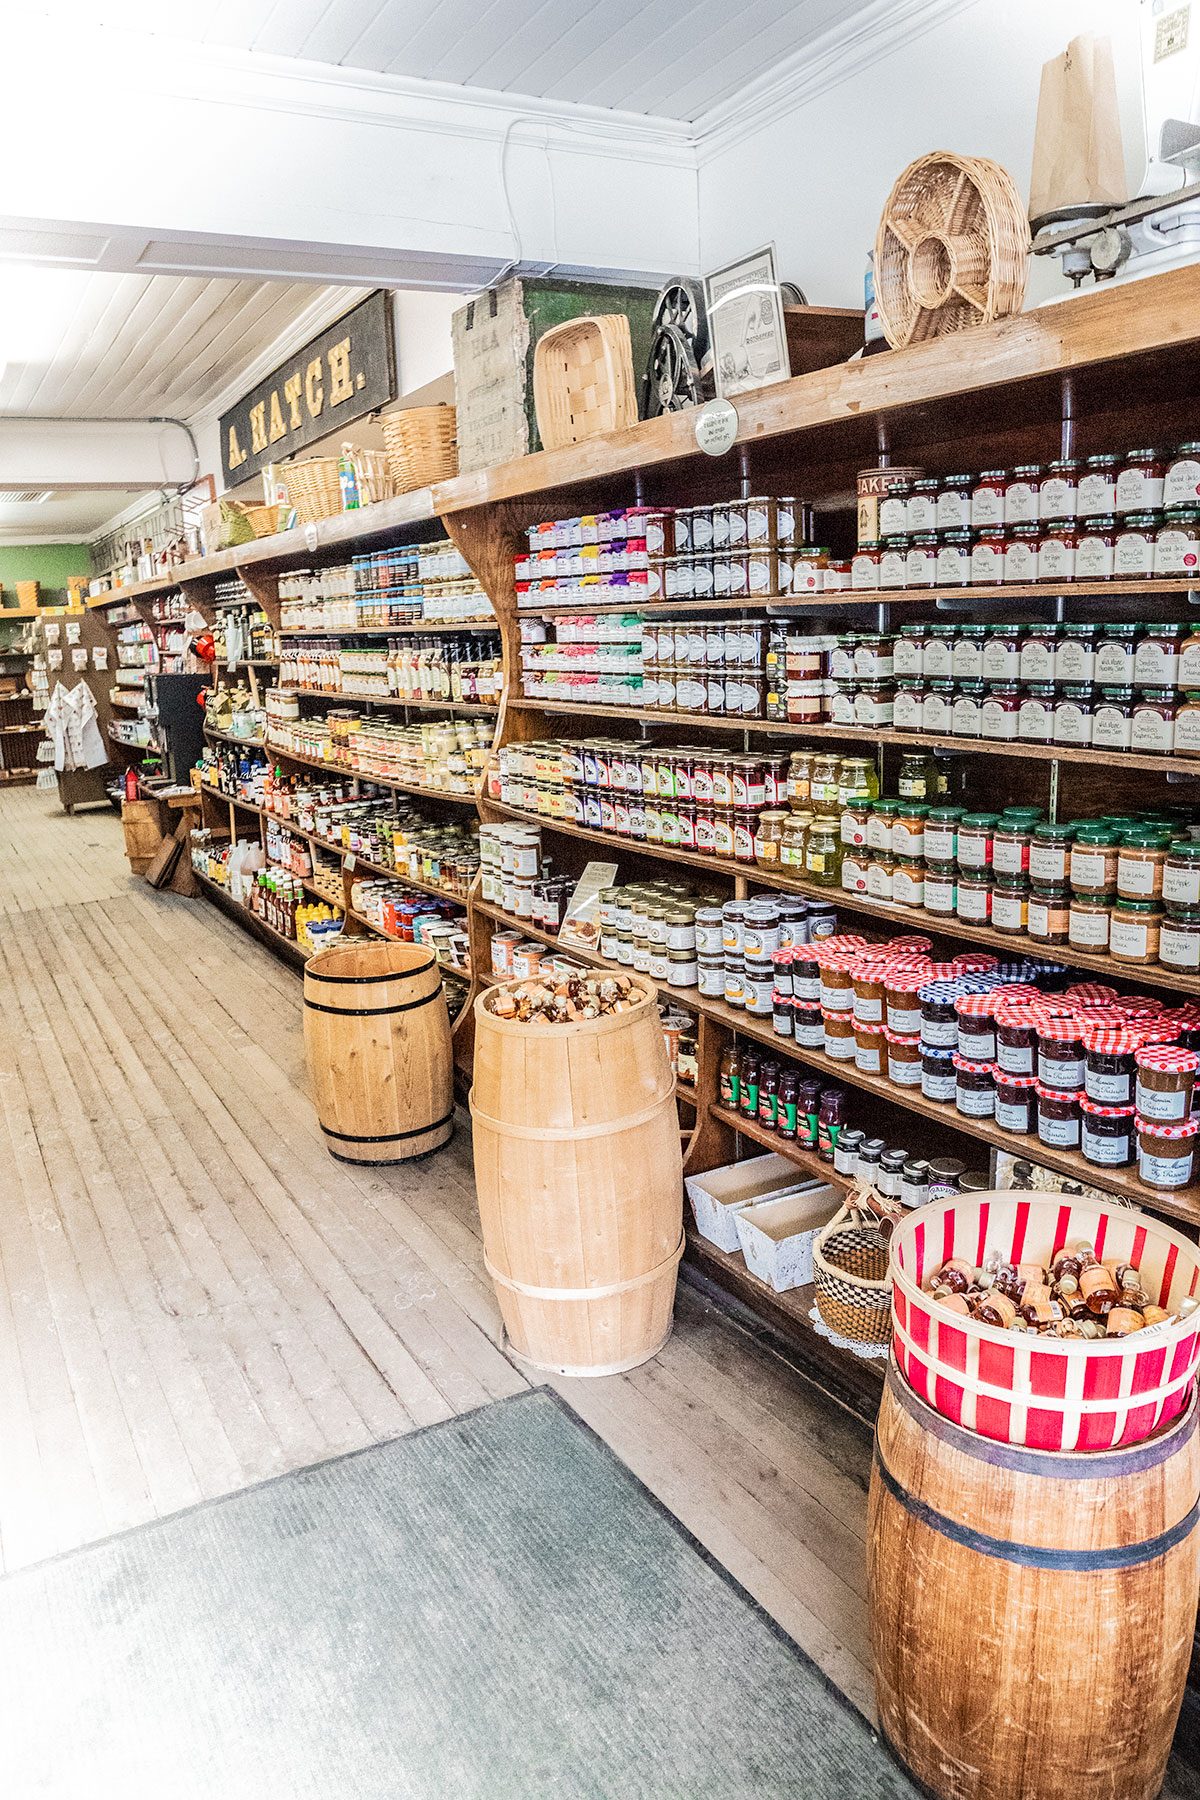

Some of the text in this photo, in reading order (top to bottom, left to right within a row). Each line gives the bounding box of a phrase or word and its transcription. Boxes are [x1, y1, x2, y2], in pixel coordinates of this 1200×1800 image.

[229, 337, 366, 470] A. HATCH.
[858, 476, 906, 494] AKE
